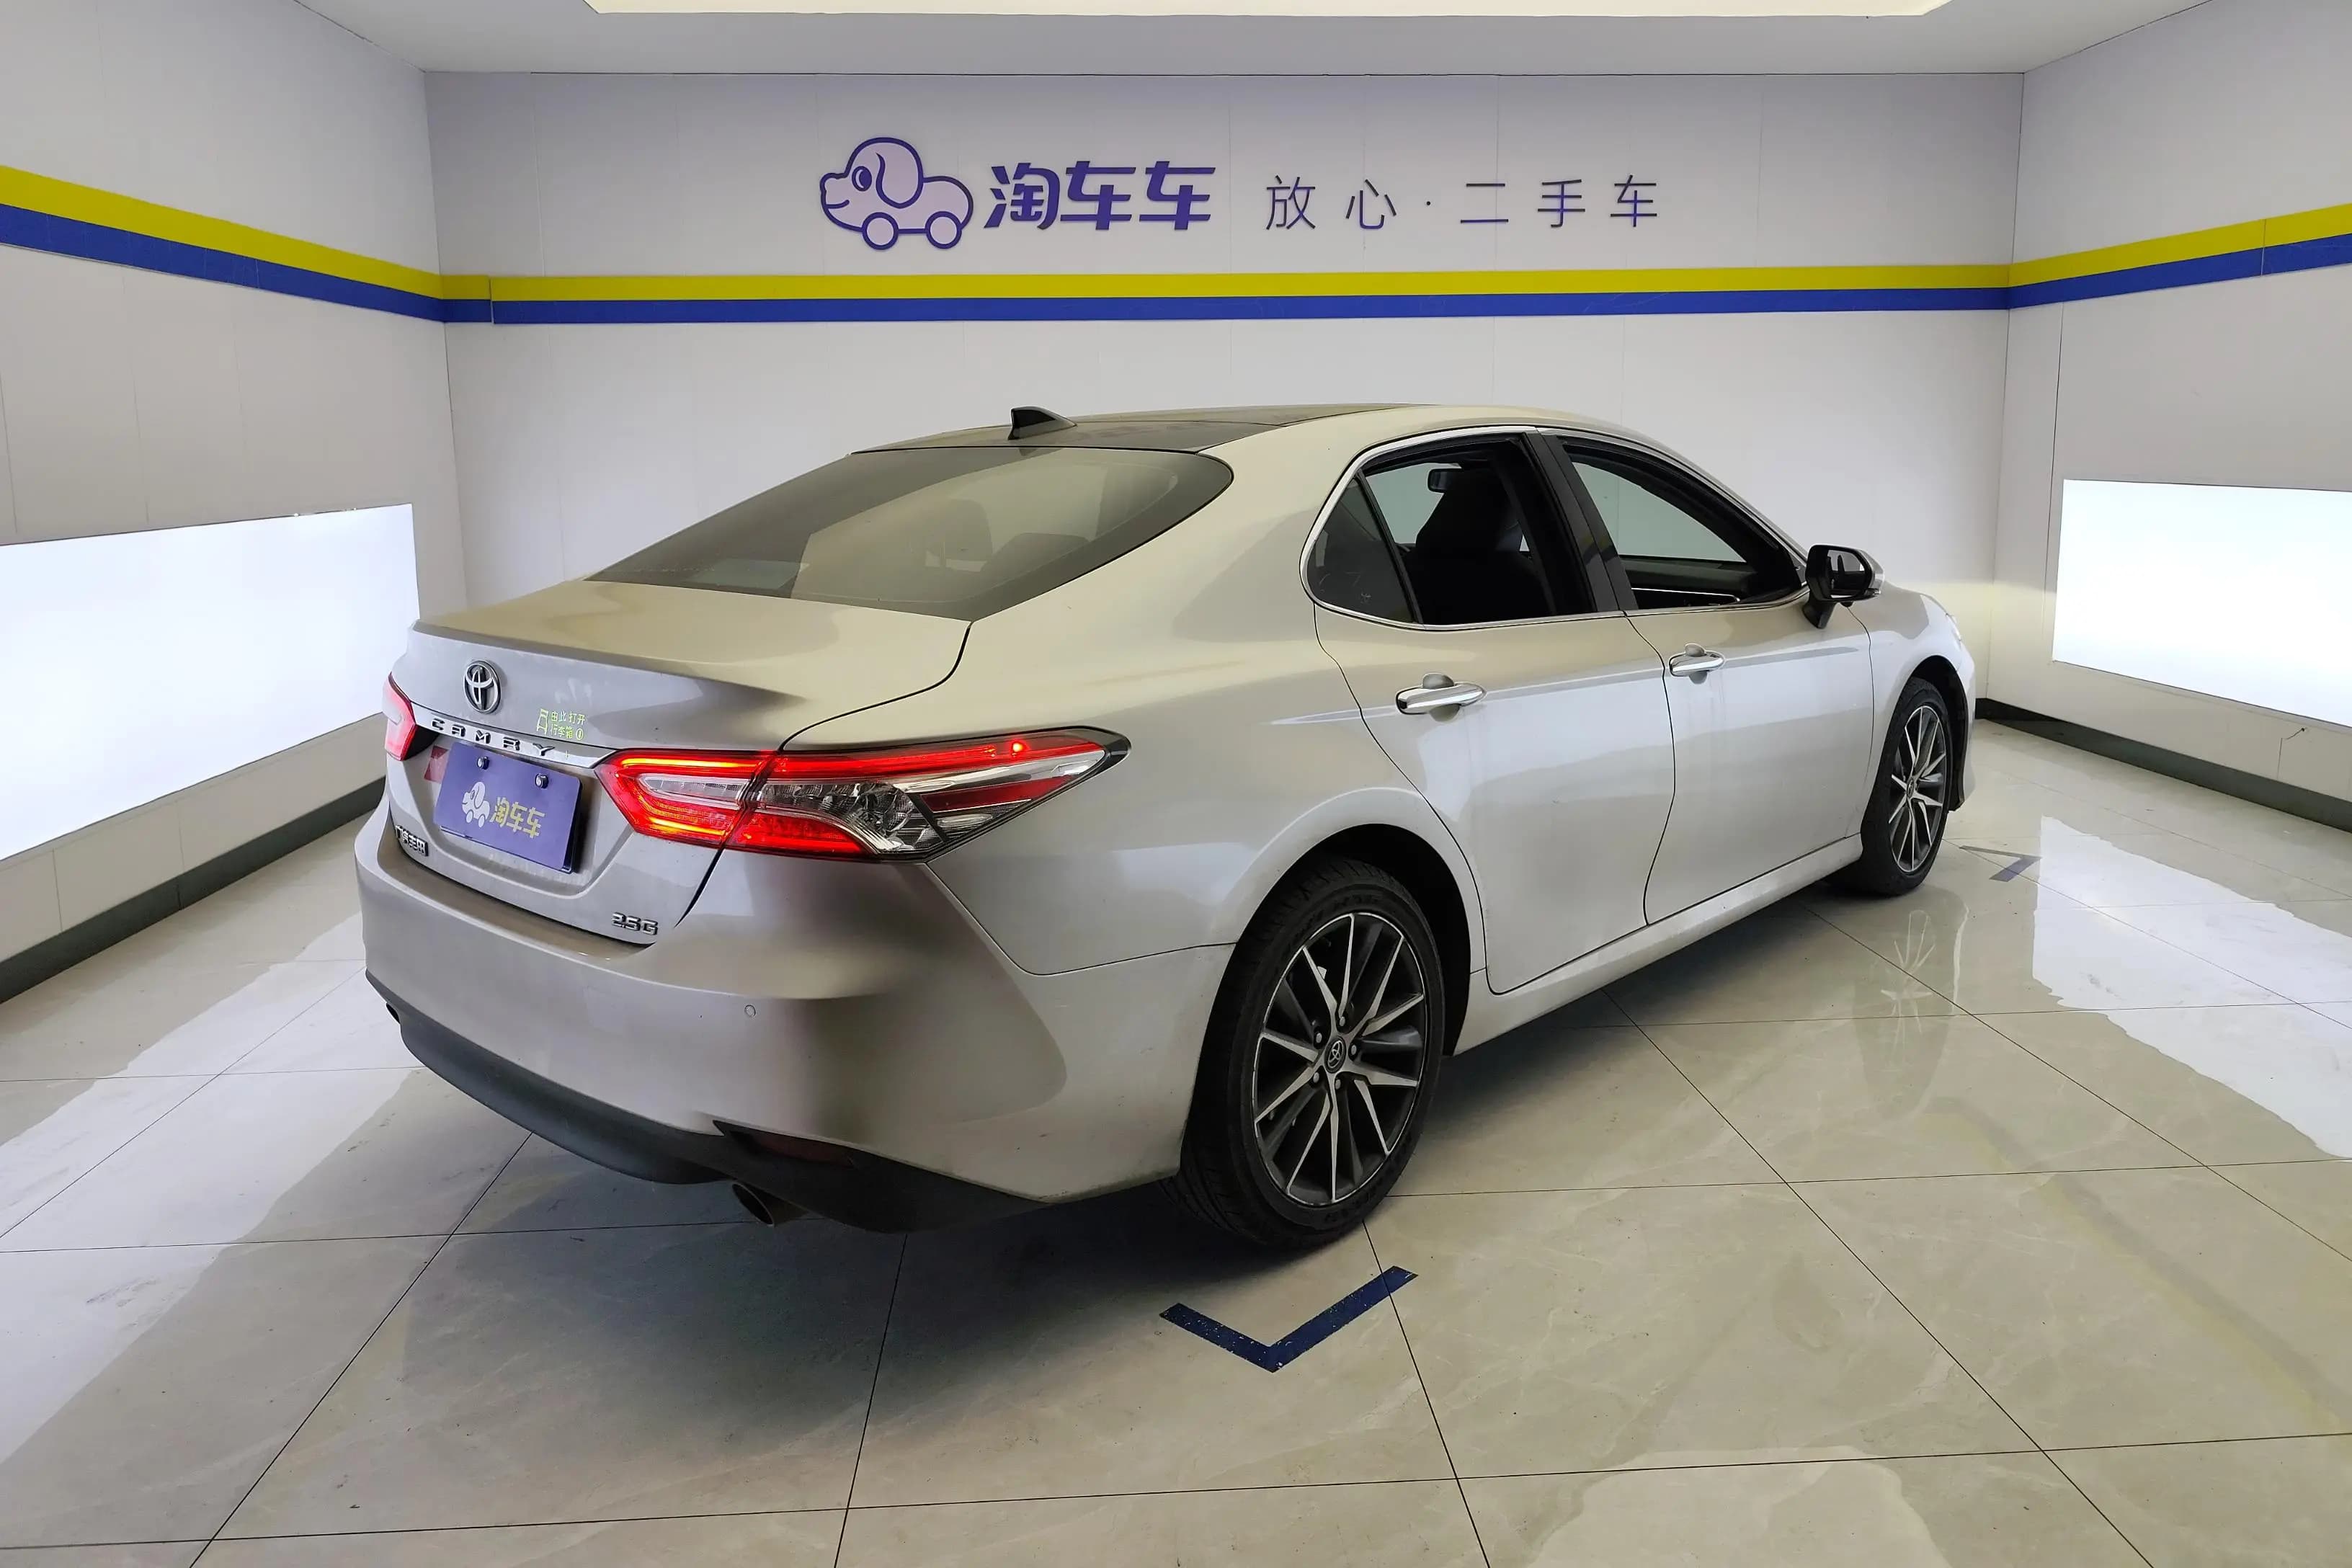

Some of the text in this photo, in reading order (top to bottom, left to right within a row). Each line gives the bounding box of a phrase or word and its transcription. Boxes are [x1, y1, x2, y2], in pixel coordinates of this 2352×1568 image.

[984, 161, 1216, 230] 淘车车
[432, 718, 555, 756] CAMRY
[489, 796, 545, 838] 淘车车
